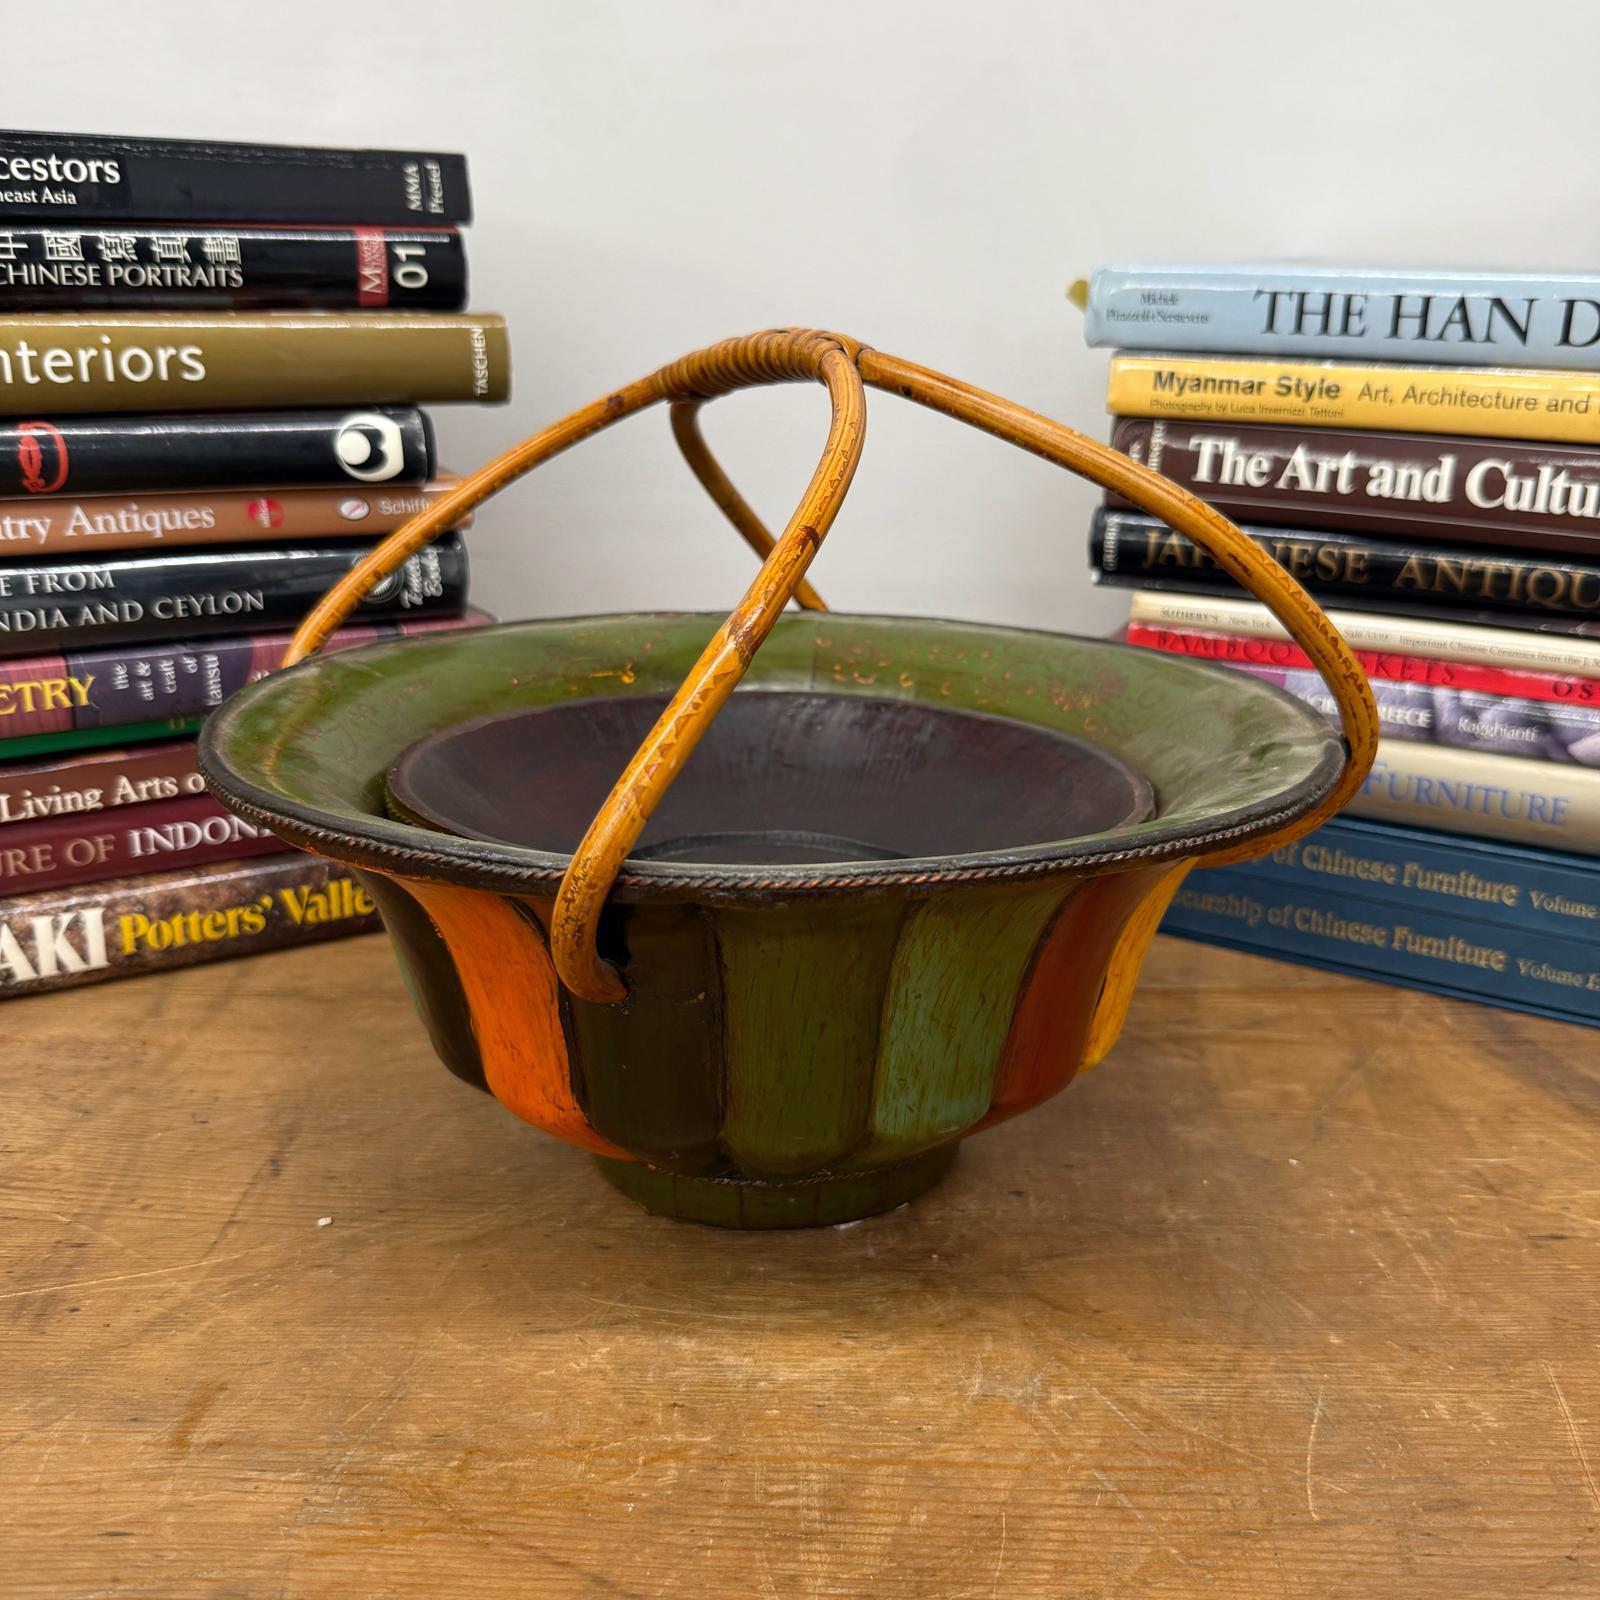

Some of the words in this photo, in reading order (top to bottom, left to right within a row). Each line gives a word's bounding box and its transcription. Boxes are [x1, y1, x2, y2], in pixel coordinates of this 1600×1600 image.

[41, 186, 78, 204] Asia
[403, 160, 423, 212] MMA
[106, 262, 243, 288] PORTRAITS
[391, 243, 429, 289] 01
[1253, 289, 1369, 339] THE
[1384, 293, 1540, 347] HAN
[471, 327, 488, 396] TASCHEN
[1153, 370, 1266, 397] Myanmar
[1275, 376, 1341, 402] Style
[1357, 381, 1393, 406] Art,
[1402, 384, 1538, 412] Architecture
[1546, 392, 1590, 414] and
[1188, 435, 1272, 488] The
[1274, 442, 1357, 495] Art
[1366, 453, 1458, 504] and
[1465, 457, 1600, 519] Cultu
[64, 502, 216, 539] Antiques
[25, 570, 115, 595] FROM
[78, 599, 144, 626] AND
[151, 589, 265, 620] CEYLON
[112, 663, 130, 690] the
[136, 661, 152, 677] &
[1358, 650, 1455, 684] KETS
[0, 784, 104, 823] Living
[111, 774, 179, 807] Arts
[182, 772, 206, 794] o
[0, 843, 57, 878] RE
[64, 833, 115, 867] OF
[127, 813, 275, 858] INDON
[1302, 843, 1399, 886] Chinese
[1401, 861, 1520, 907] Furniture
[1528, 887, 1599, 919] Volume
[118, 895, 273, 957] Potters'
[279, 877, 376, 927] Valle
[1267, 903, 1294, 928] of
[1294, 906, 1389, 949] Chinese
[1391, 925, 1509, 972] Furniture
[1515, 957, 1585, 988] Volume
